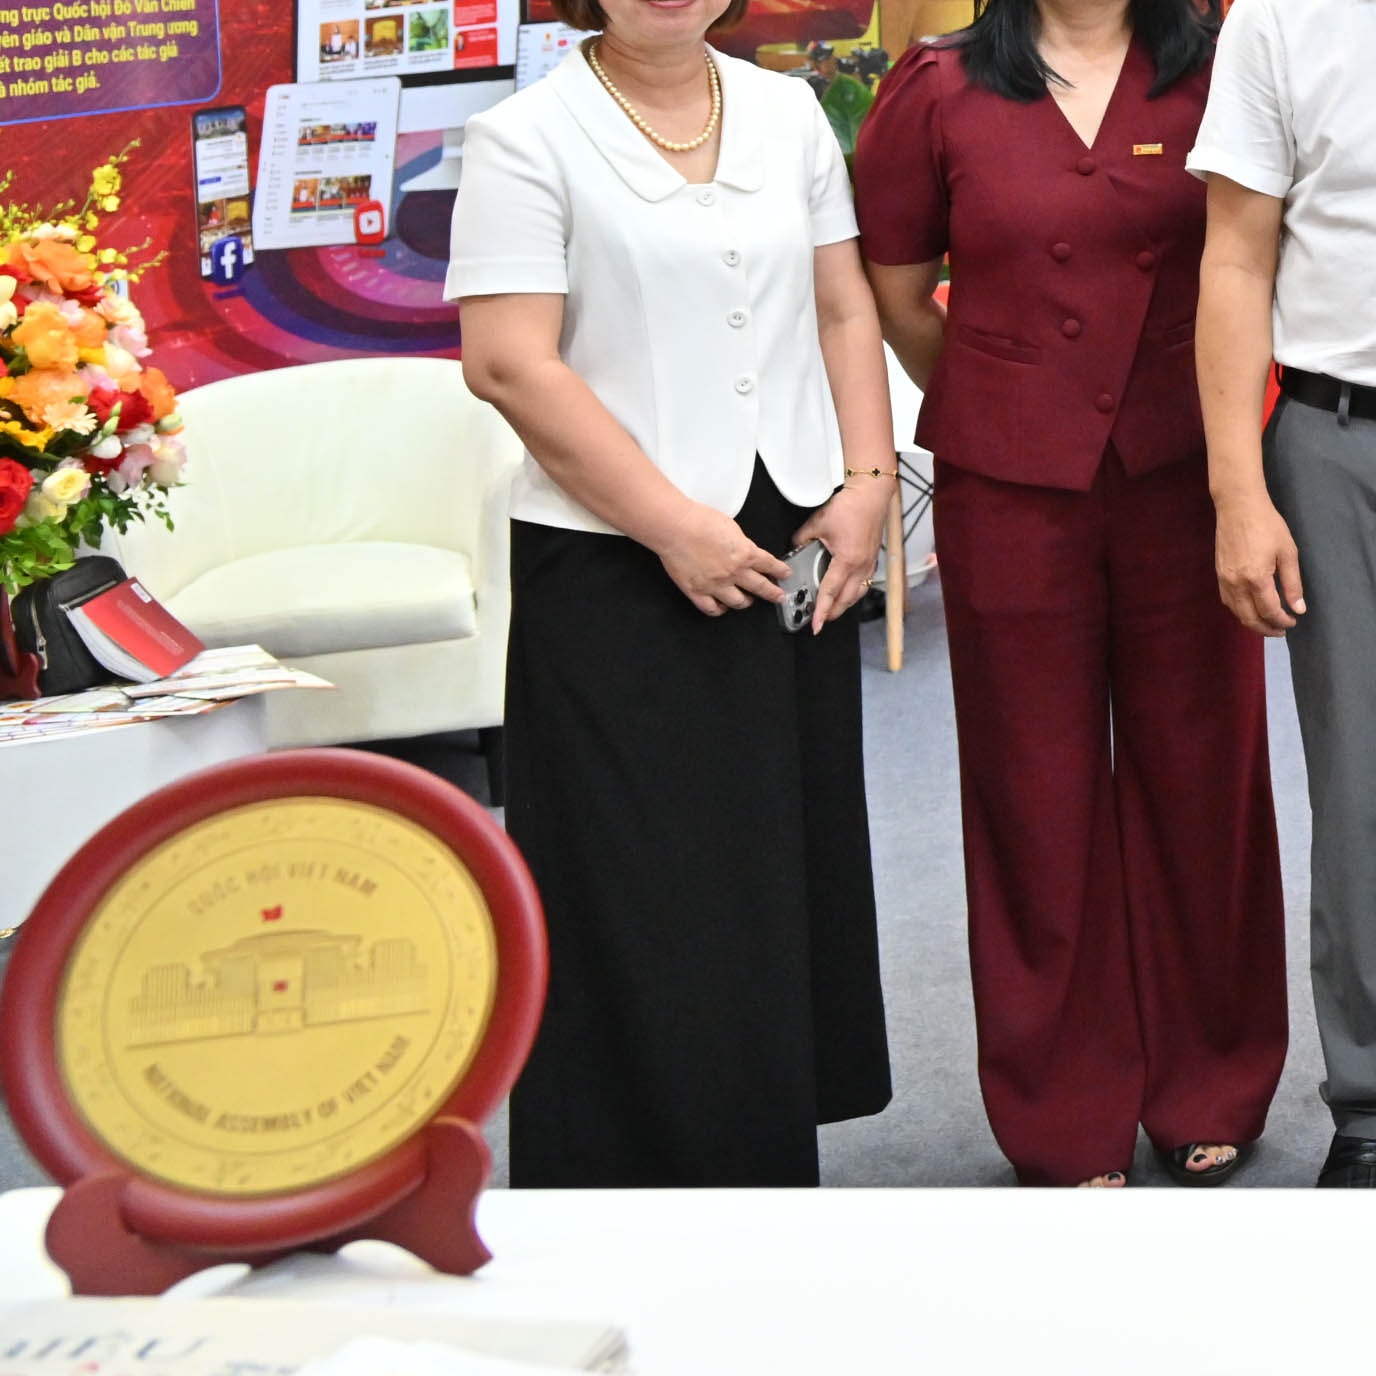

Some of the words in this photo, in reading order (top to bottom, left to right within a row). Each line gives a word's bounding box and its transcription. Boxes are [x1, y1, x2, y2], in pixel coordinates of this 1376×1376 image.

[52, 0, 88, 21] Quốc
[55, 26, 71, 45] và
[73, 22, 101, 44] Dân
[128, 19, 165, 41] Trung
